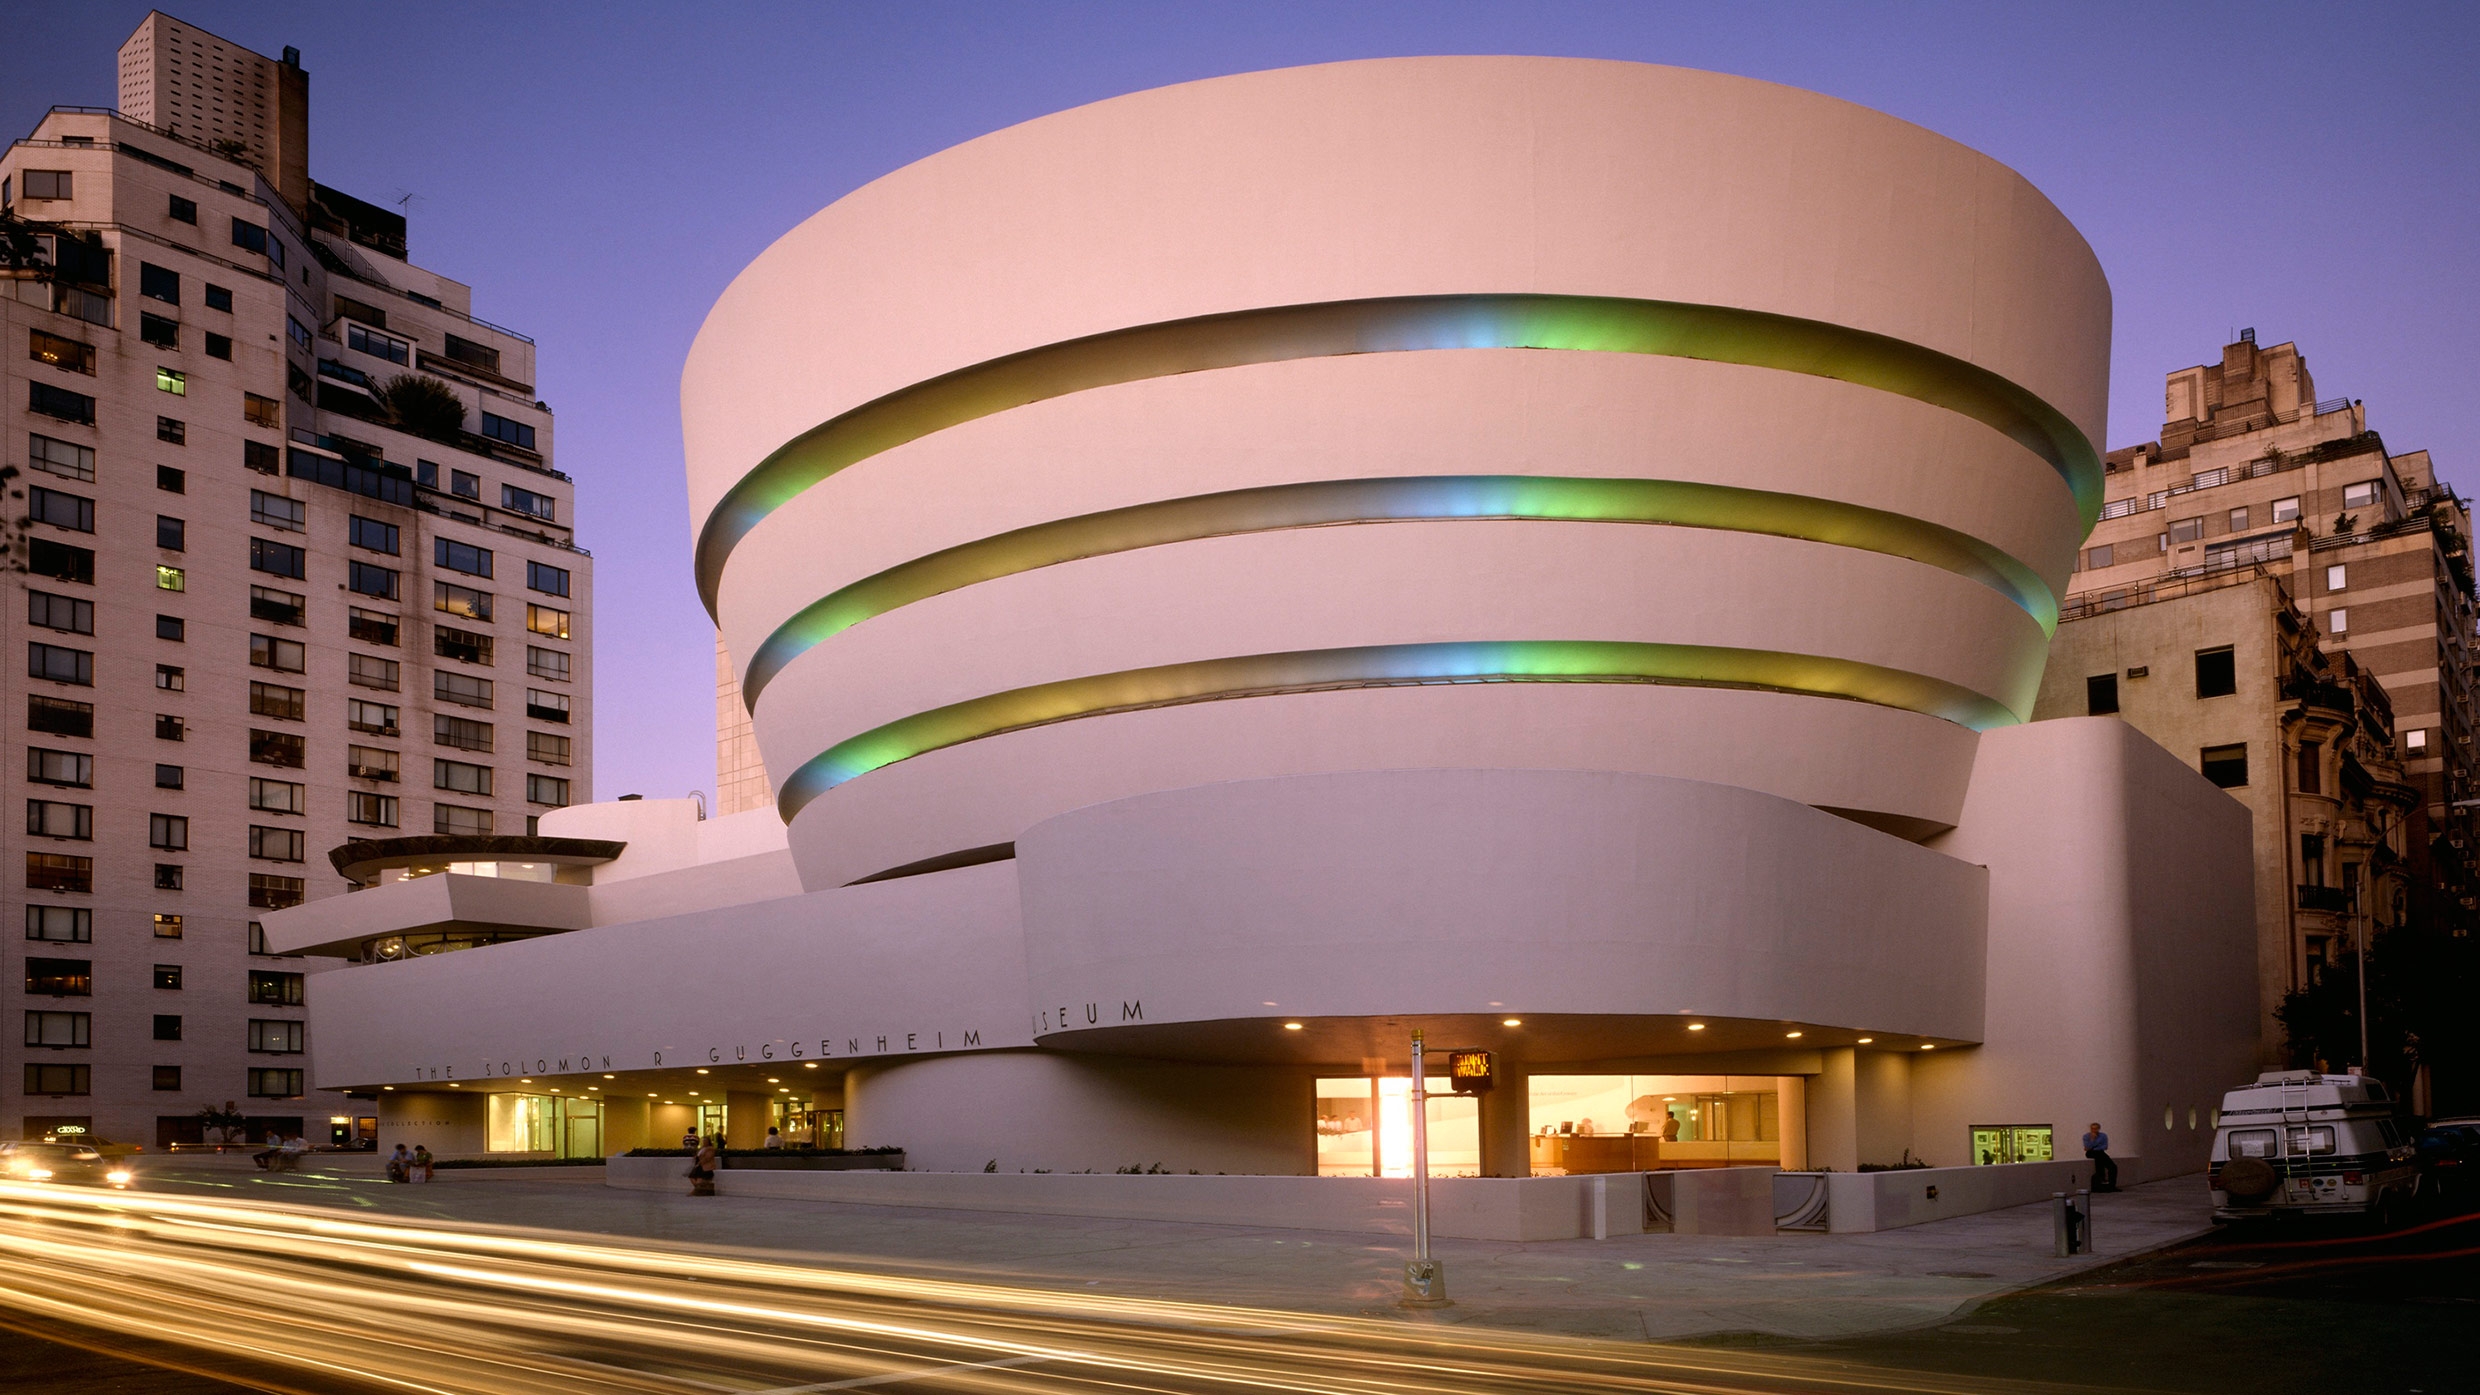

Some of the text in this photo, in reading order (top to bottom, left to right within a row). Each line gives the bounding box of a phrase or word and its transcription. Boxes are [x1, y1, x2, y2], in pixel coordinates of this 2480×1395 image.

[416, 1066, 452, 1081] THE
[486, 1055, 611, 1077] SOLOMON
[654, 1051, 662, 1066] R
[709, 1029, 981, 1063] GUGGENHEIM
